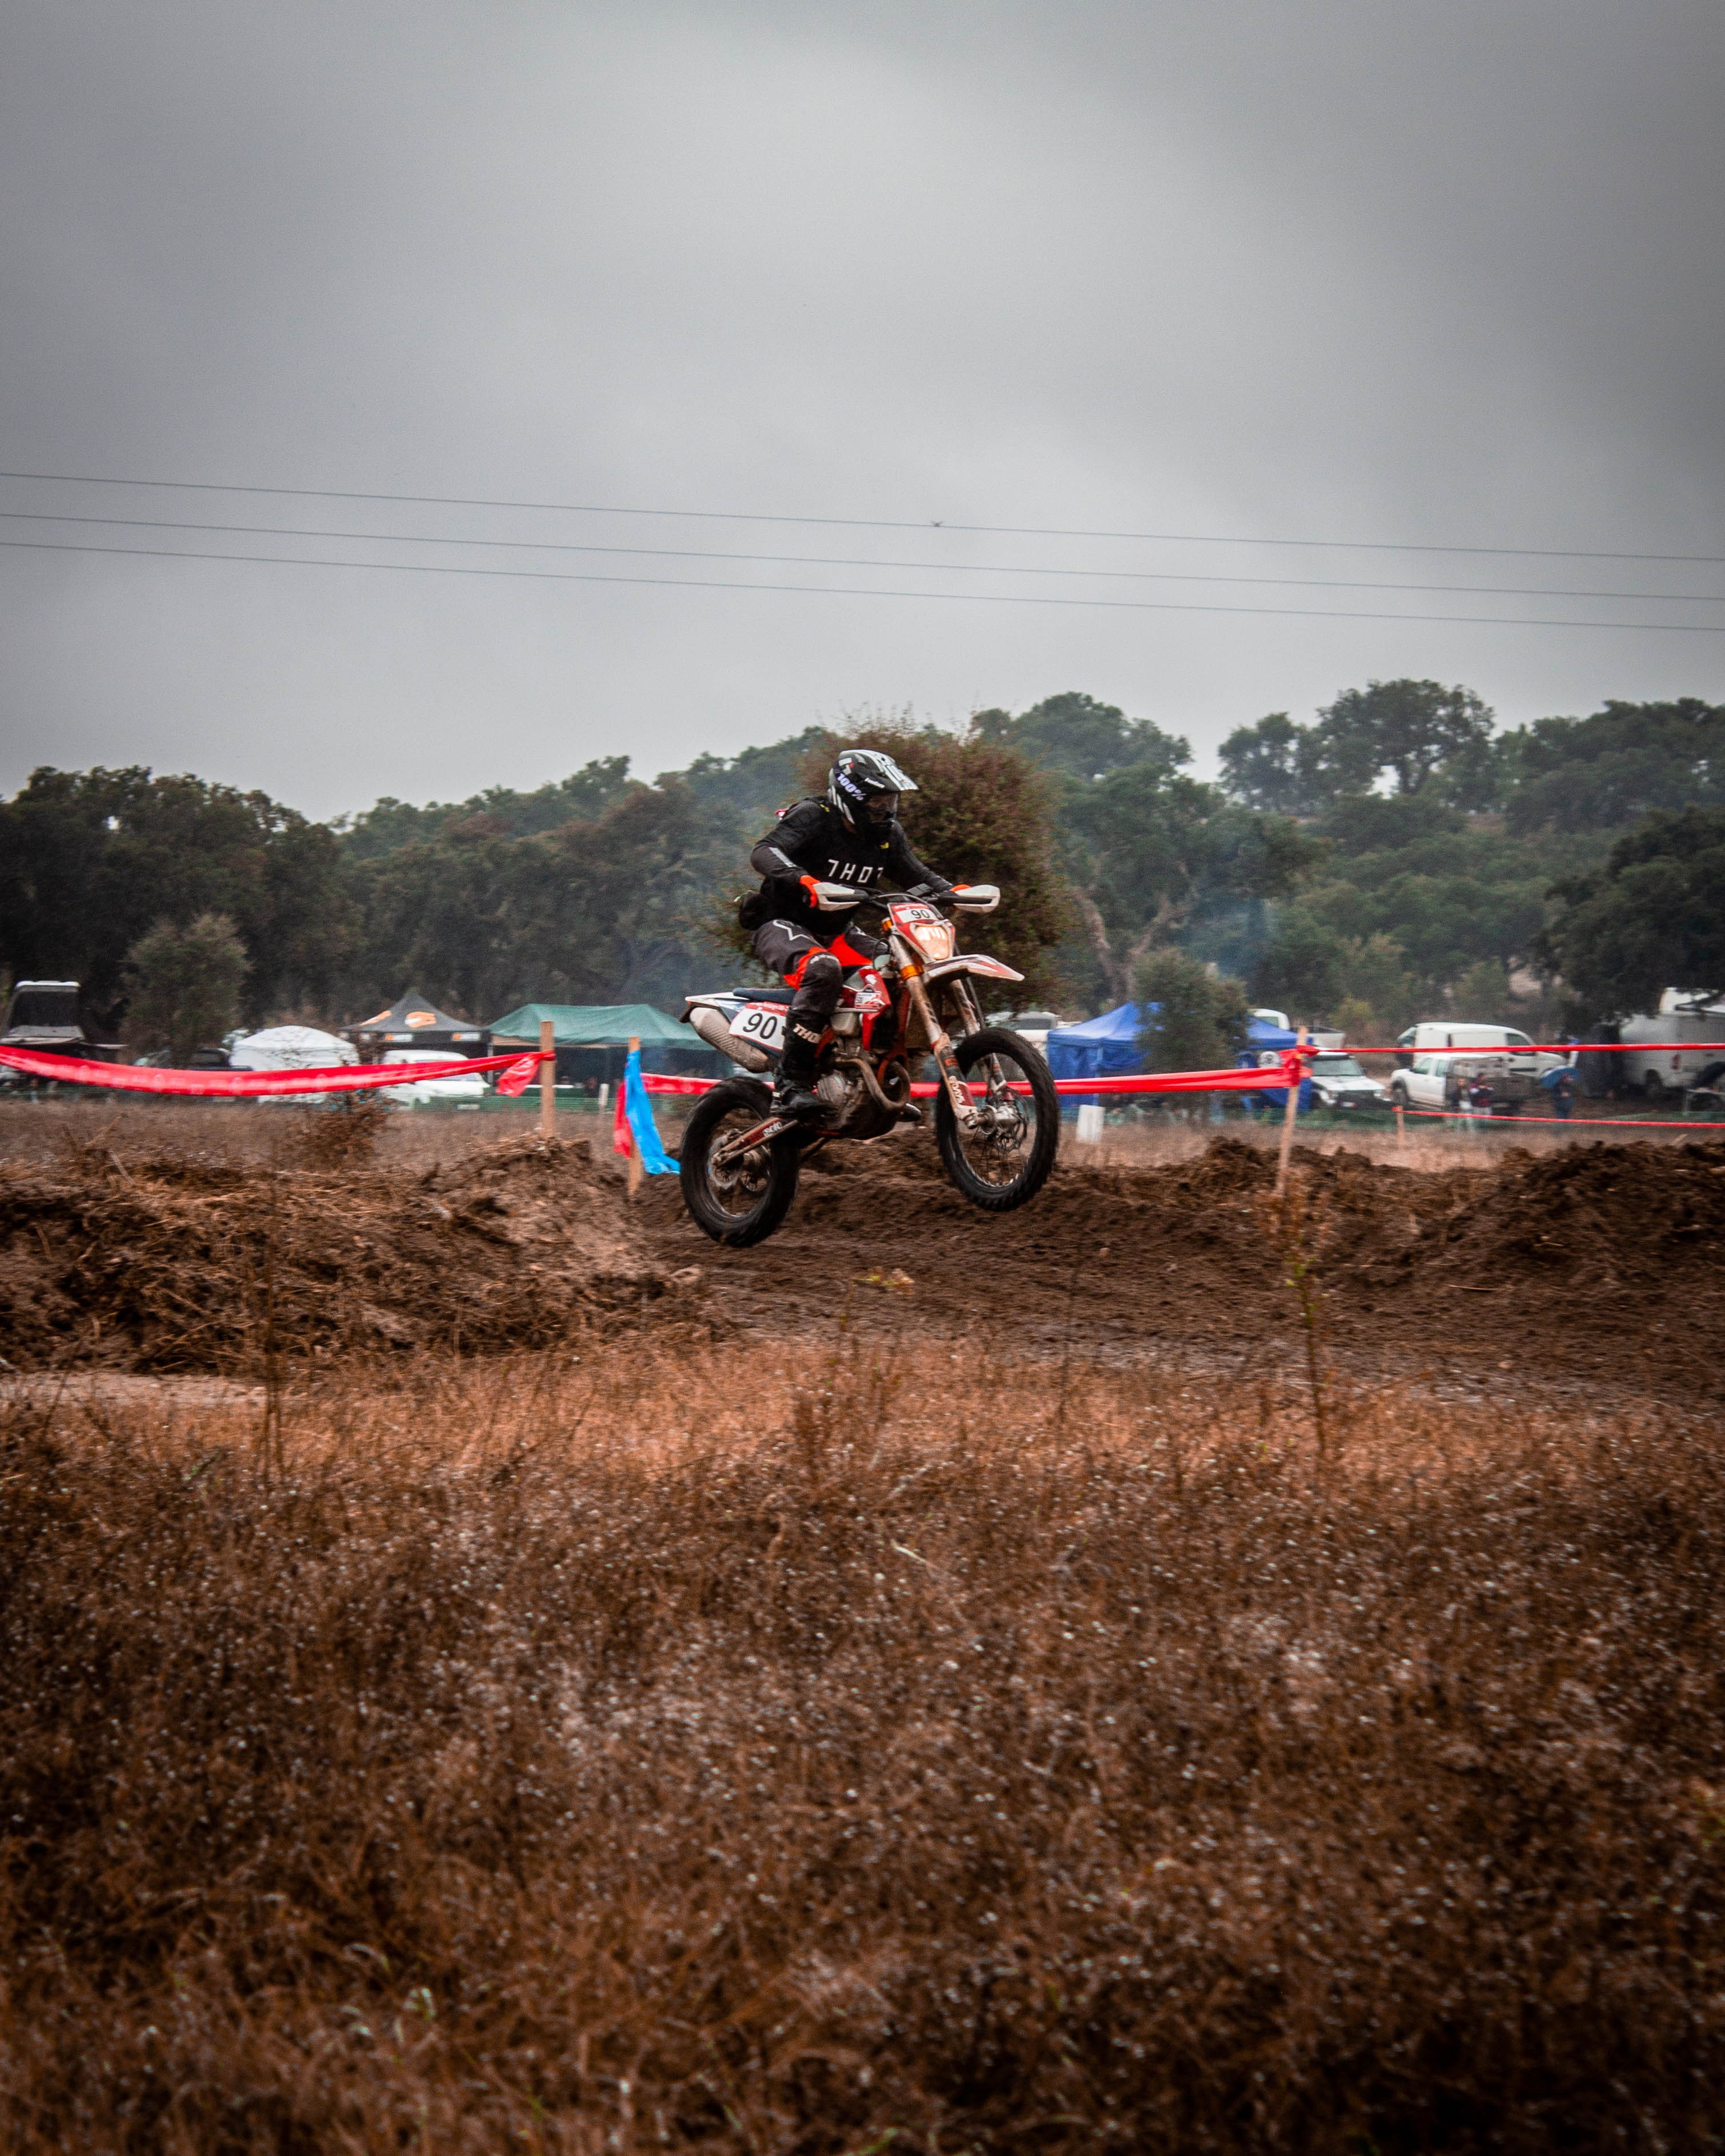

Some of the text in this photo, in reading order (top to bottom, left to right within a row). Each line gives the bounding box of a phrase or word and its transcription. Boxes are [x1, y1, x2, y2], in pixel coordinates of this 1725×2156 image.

[837, 773, 867, 800] 100%
[910, 909, 930, 920] 90
[743, 1013, 778, 1040] 90
[792, 1023, 821, 1044] THO
